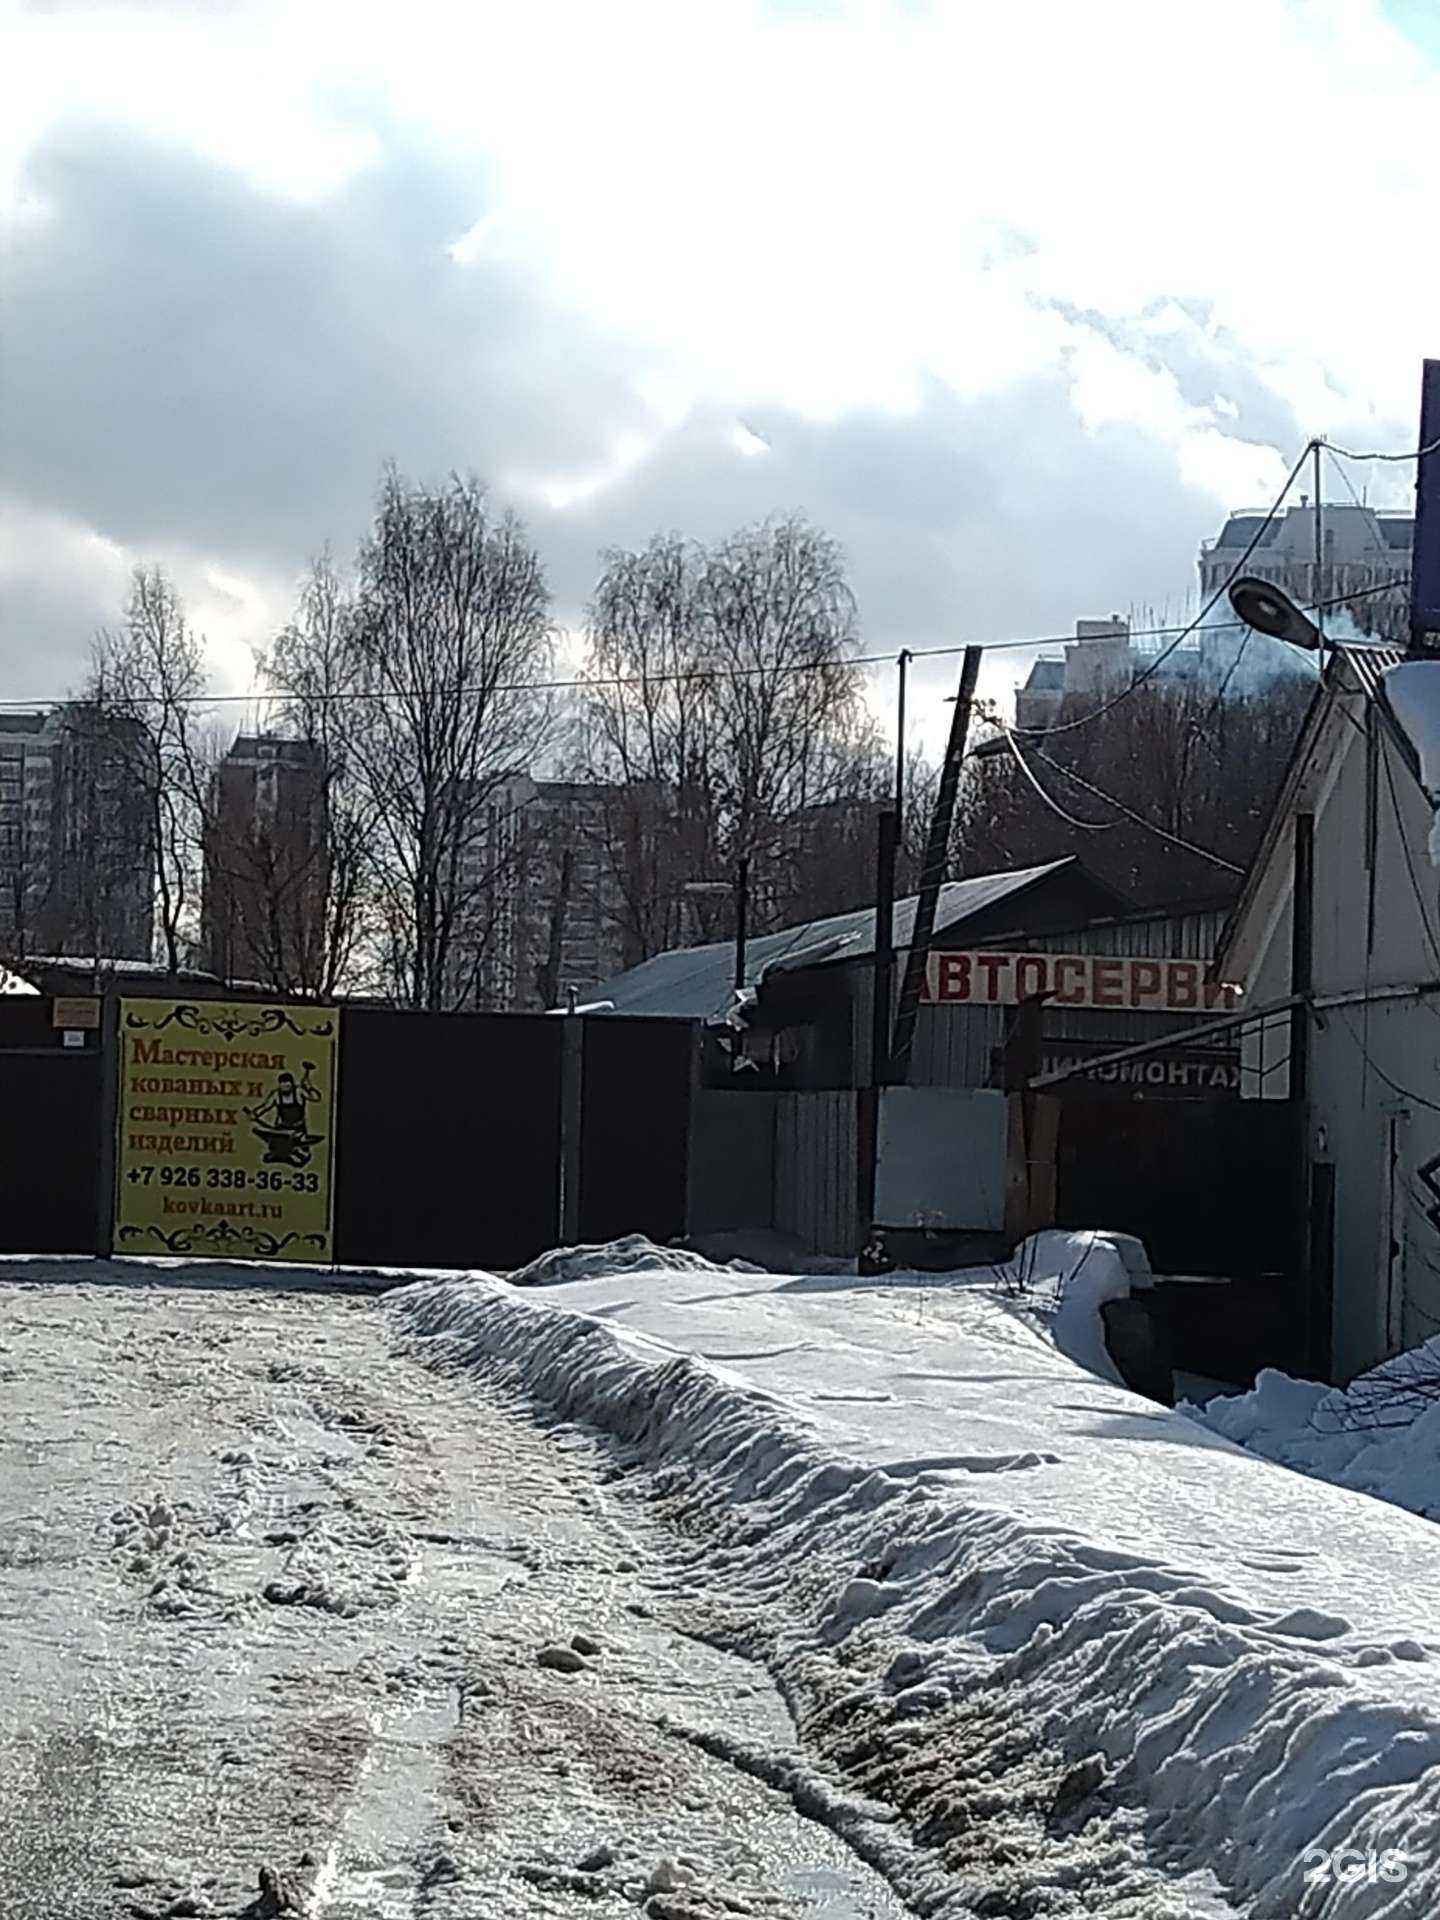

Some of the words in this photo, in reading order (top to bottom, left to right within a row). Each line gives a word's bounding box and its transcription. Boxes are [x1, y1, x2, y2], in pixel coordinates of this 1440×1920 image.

[131, 1038, 286, 1072] Мастерская
[130, 1076, 242, 1096] кованых
[249, 1081, 264, 1098] и
[129, 1105, 239, 1126] сварных
[129, 1131, 235, 1155] изделий
[127, 1166, 154, 1185] +7
[160, 1167, 201, 1187] 926
[206, 1168, 319, 1192] 338-36-33
[162, 1197, 283, 1219] kovkaart.ru
